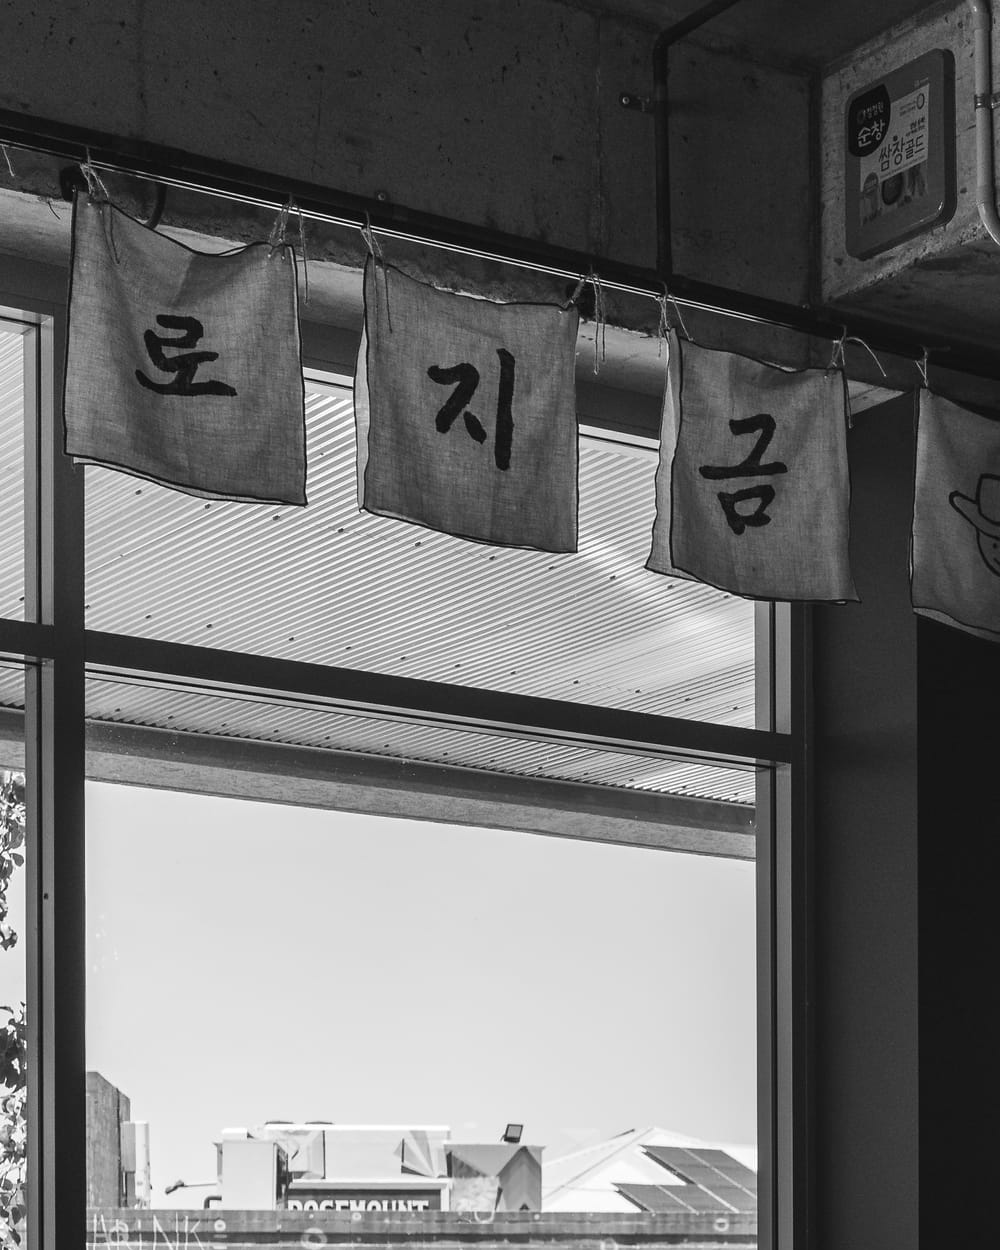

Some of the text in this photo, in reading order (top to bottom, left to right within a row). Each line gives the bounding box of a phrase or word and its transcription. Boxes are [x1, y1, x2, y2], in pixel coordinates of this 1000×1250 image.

[857, 119, 886, 148] 순창
[134, 313, 789, 535] 로 지 금
